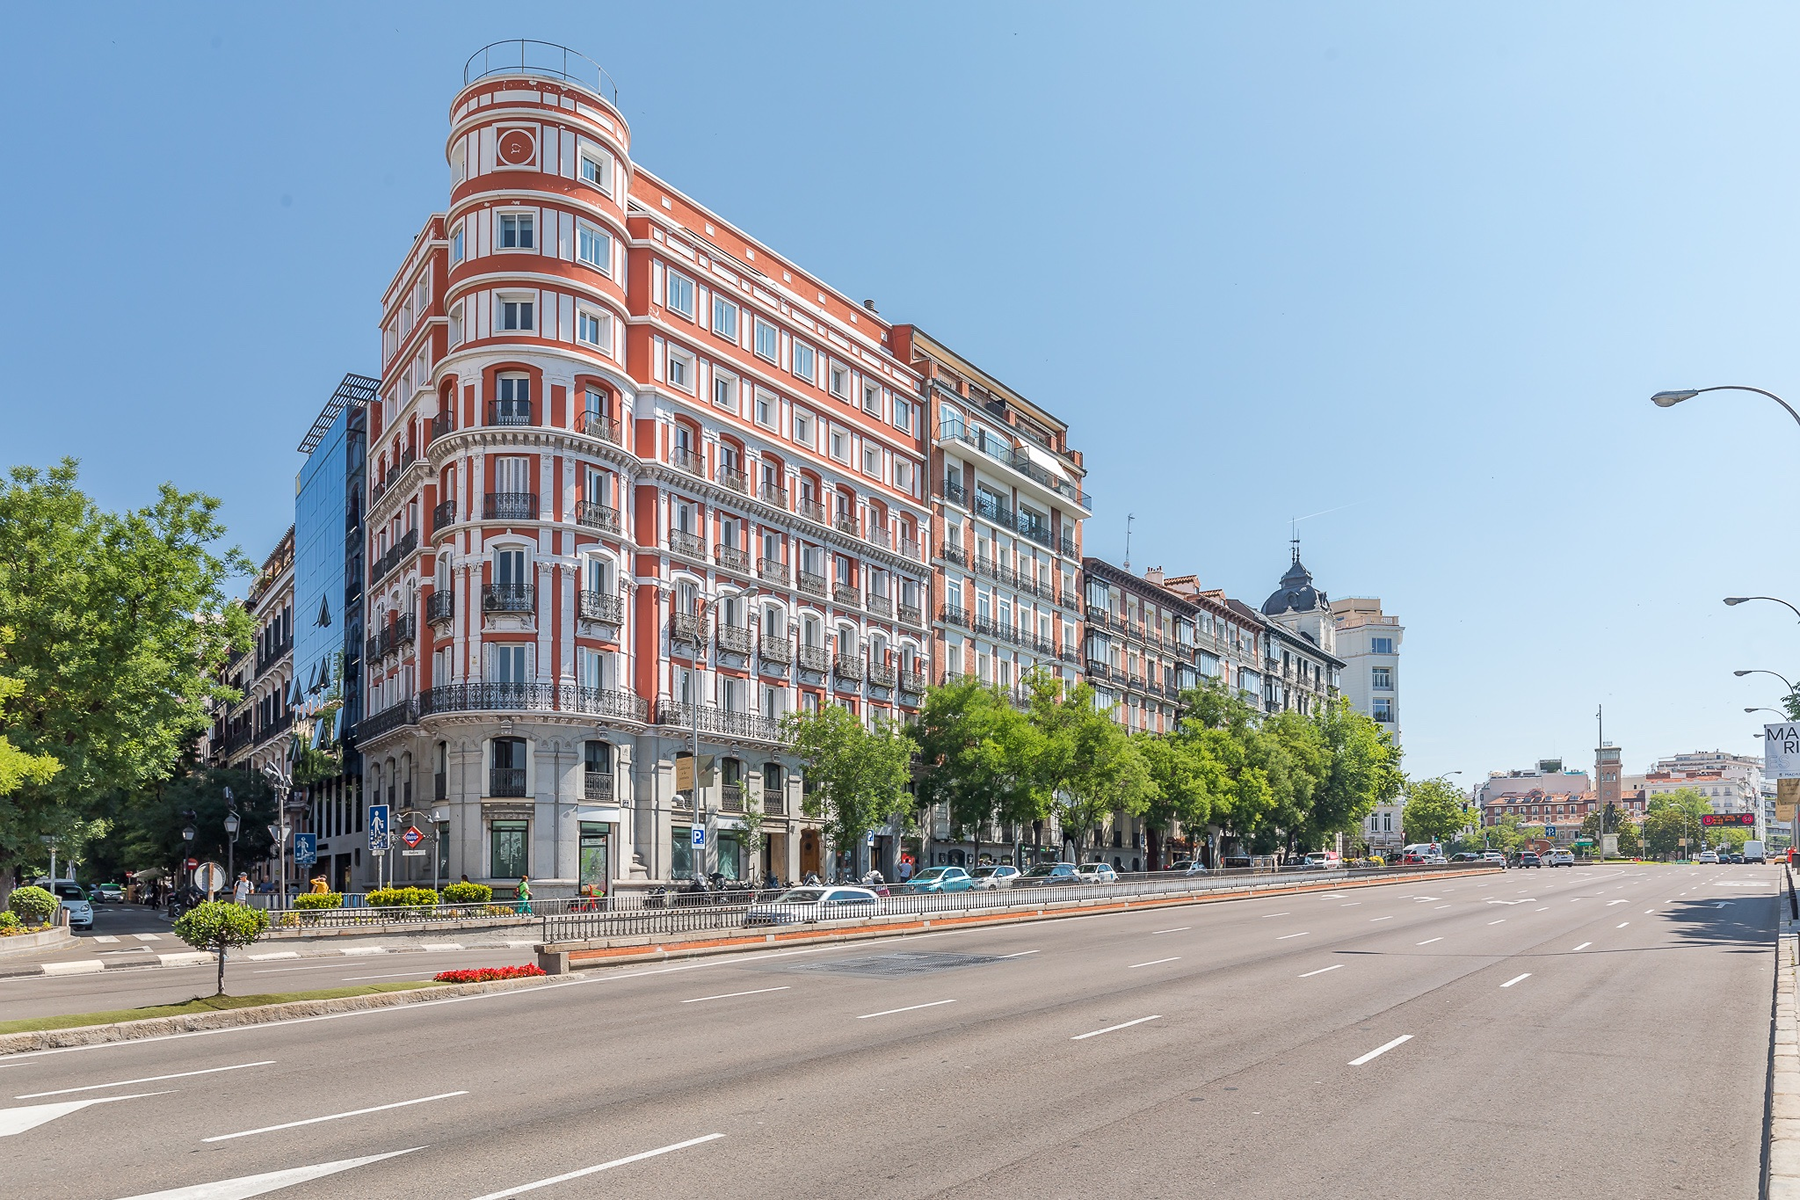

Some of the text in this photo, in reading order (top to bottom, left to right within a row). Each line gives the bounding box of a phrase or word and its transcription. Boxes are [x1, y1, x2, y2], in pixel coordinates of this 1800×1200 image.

[1767, 727, 1799, 741] MA
[1784, 741, 1799, 754] RI
[1767, 755, 1790, 769] ES
[694, 831, 701, 842] P
